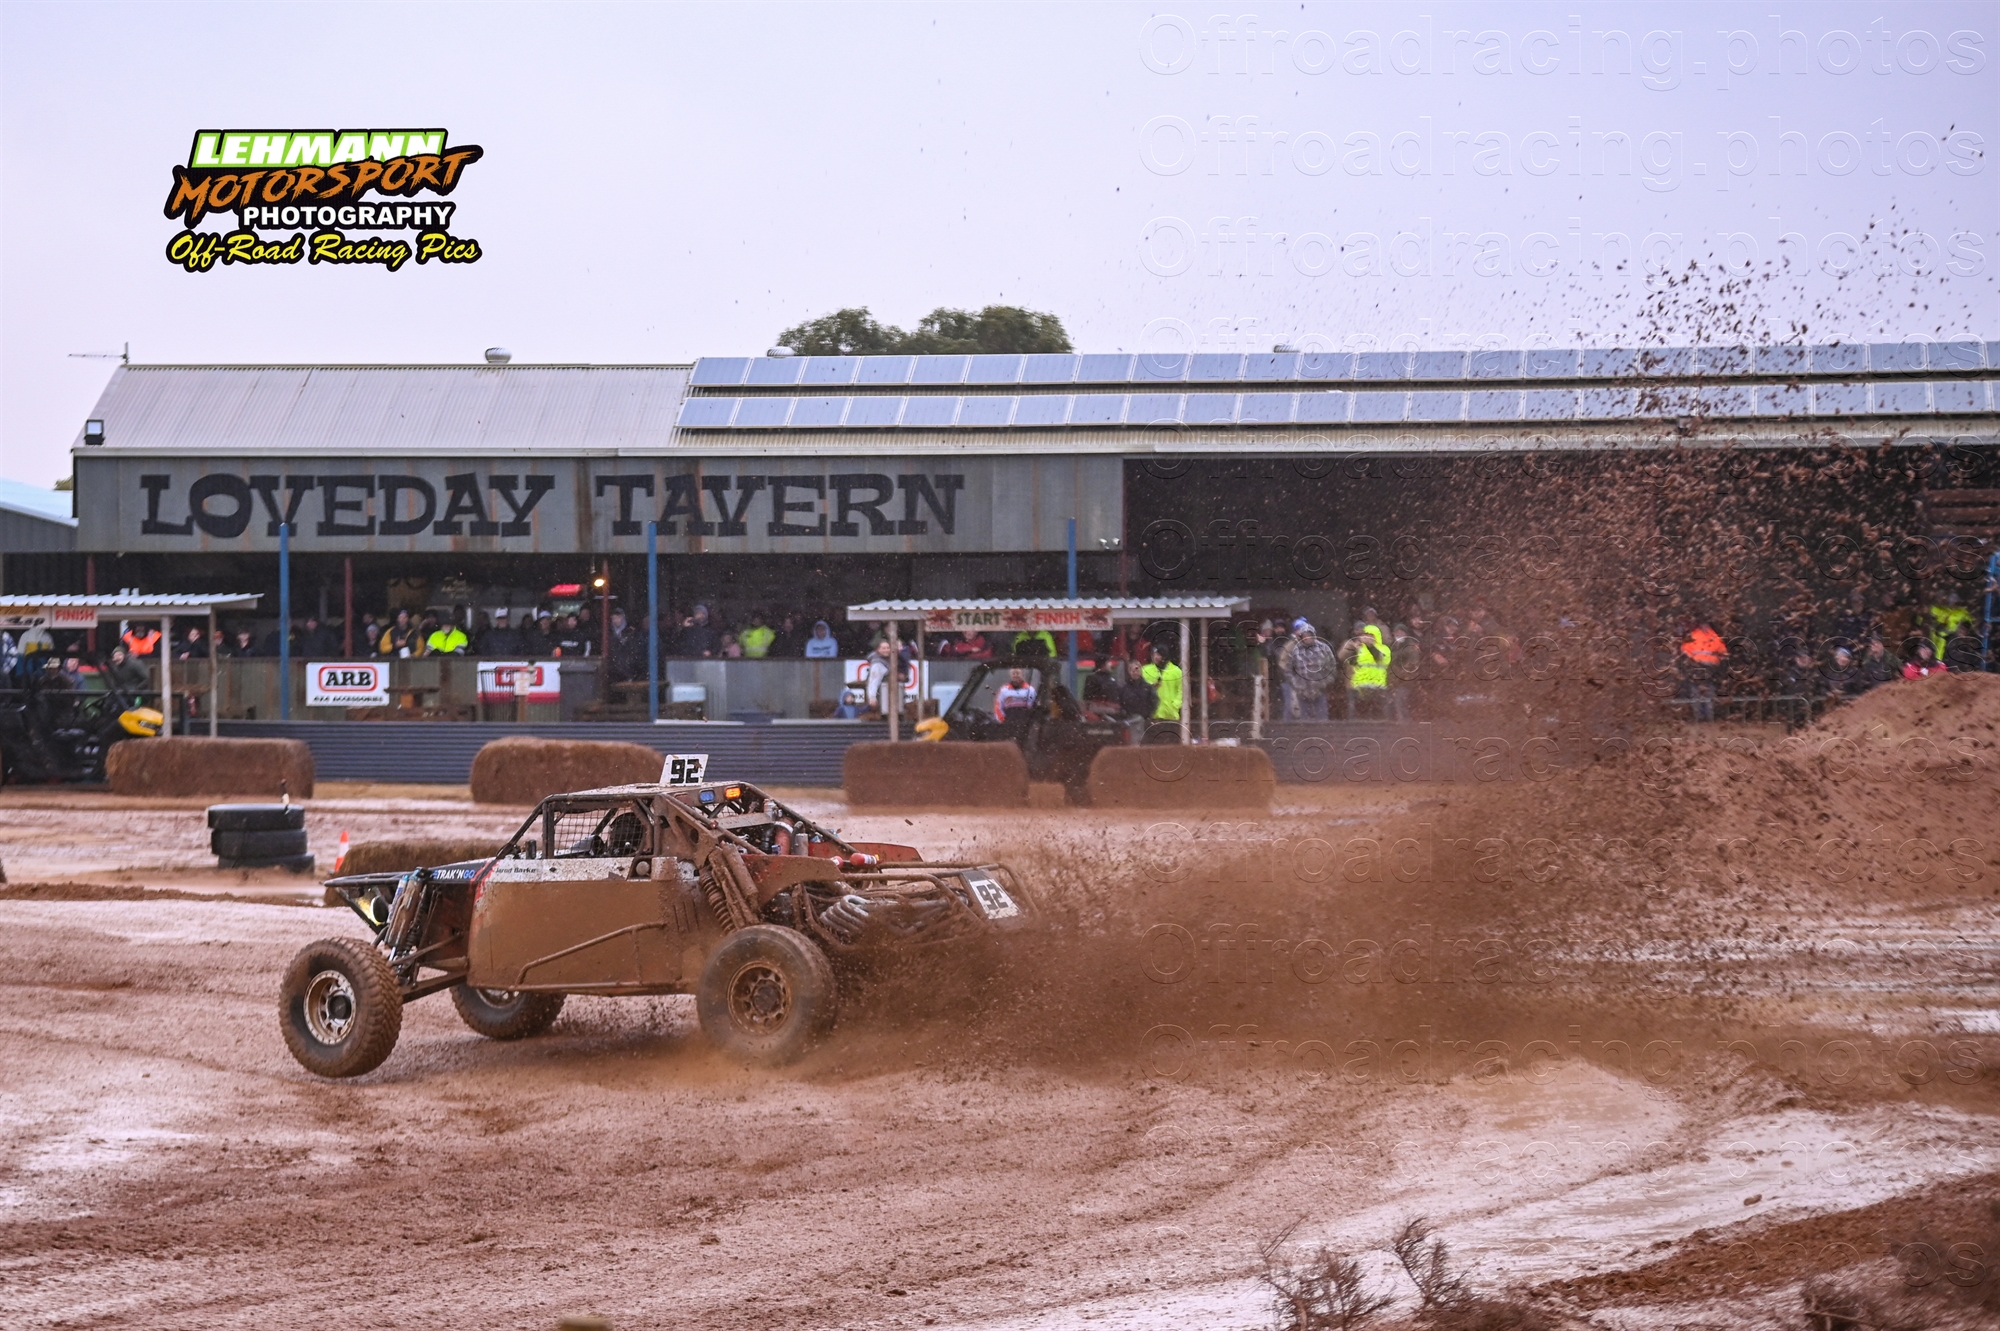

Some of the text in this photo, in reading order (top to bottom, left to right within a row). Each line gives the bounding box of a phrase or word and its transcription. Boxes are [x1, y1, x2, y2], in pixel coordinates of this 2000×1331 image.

[140, 473, 965, 537] LOVEDAY TAVERN
[55, 608, 95, 621] FINISH
[956, 611, 1081, 626] START FINISH
[325, 671, 371, 686] ARB
[669, 758, 700, 784] 92
[976, 883, 1009, 911] 92
